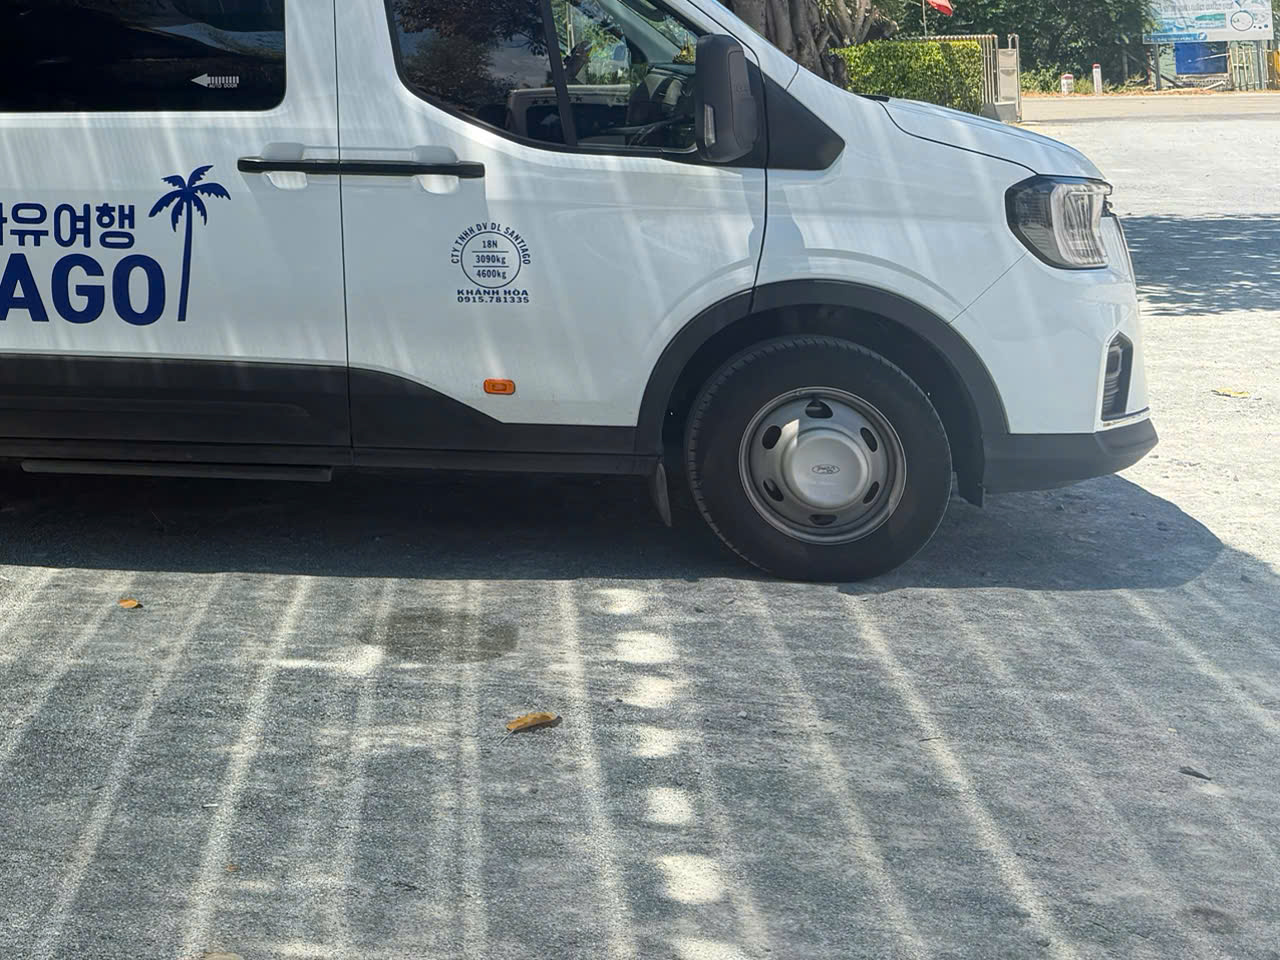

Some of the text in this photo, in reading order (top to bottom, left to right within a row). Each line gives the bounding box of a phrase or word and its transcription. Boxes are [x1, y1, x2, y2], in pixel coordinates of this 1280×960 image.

[450, 222, 531, 265] CTY TNHH DV DL SANTIAGO
[482, 239, 498, 249] 18N
[475, 254, 506, 265] 3090kg
[476, 269, 507, 279] 4600kg
